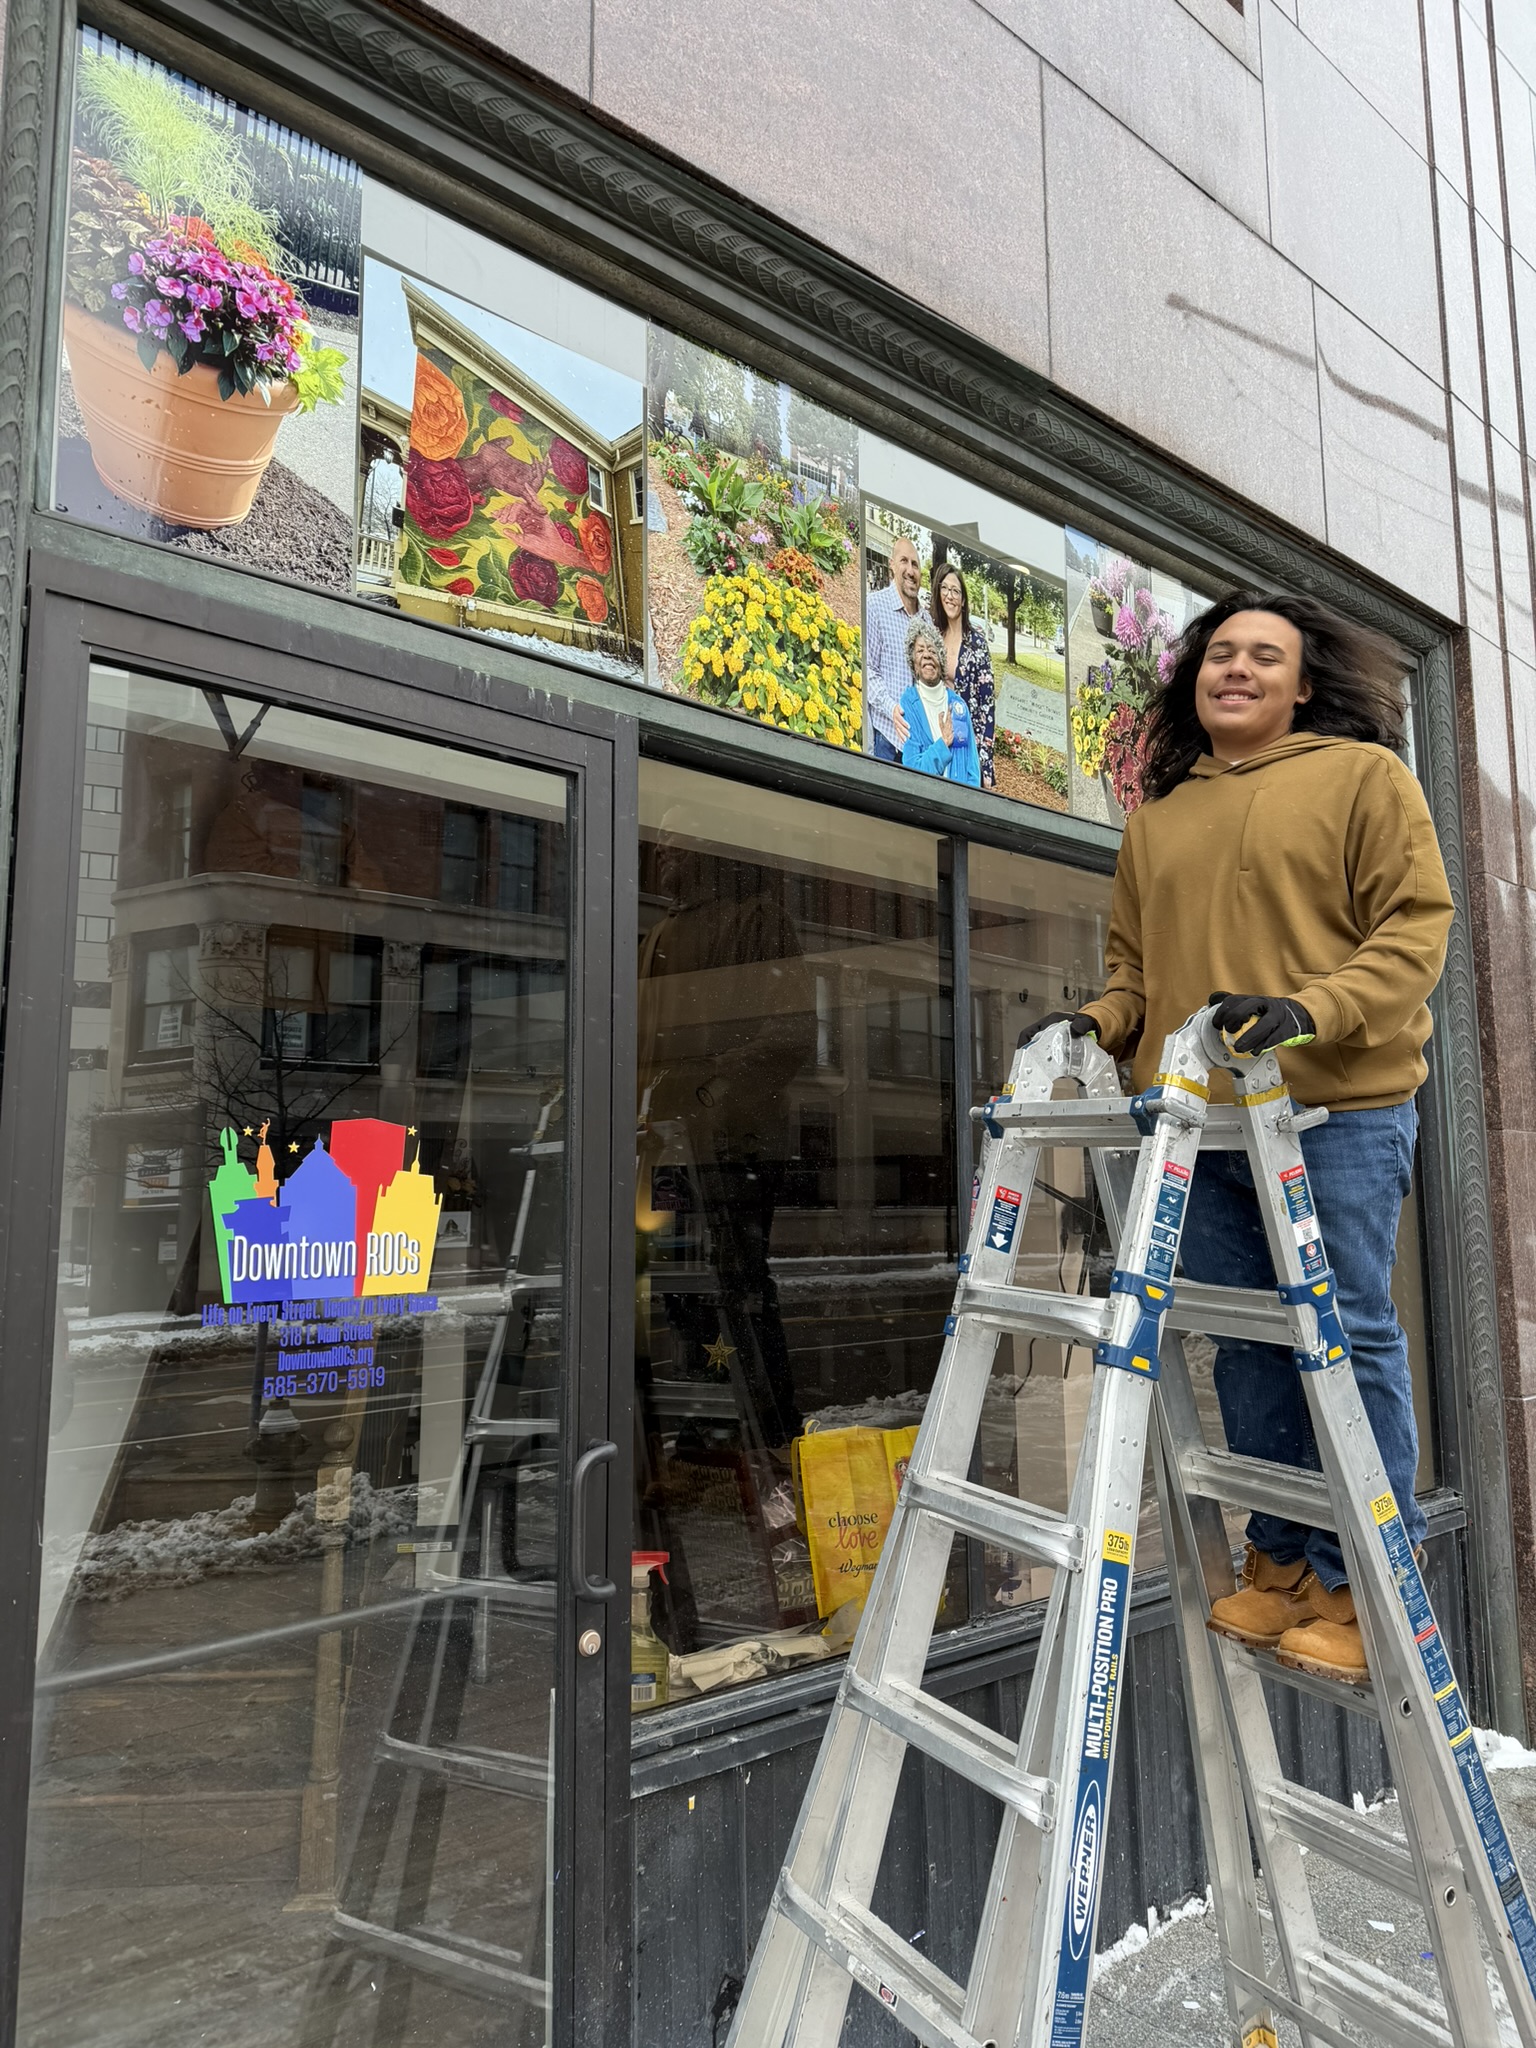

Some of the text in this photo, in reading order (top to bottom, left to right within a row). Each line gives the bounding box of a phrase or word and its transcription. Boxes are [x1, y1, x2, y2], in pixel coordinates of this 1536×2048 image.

[233, 1231, 420, 1282] Downtown ROCs
[202, 1303, 225, 1327] Life
[228, 1306, 243, 1325] on
[246, 1302, 279, 1326] Every
[282, 1300, 320, 1321] Street.
[377, 1296, 405, 1316] Every
[280, 1321, 374, 1347] 318 E. Main Street
[278, 1345, 374, 1372] DowntownROCs.org
[263, 1366, 385, 1399] 585-370-5919
[828, 1511, 878, 1528] choose
[835, 1526, 879, 1549] love
[838, 1558, 879, 1578] Wegma
[1085, 1617, 1115, 1759] MULTI-POSITION
[1100, 1577, 1118, 1614] PRO
[1102, 1738, 1110, 1760] with
[1109, 1653, 1119, 1681] RAILS
[1075, 1814, 1096, 1920] WERNER
